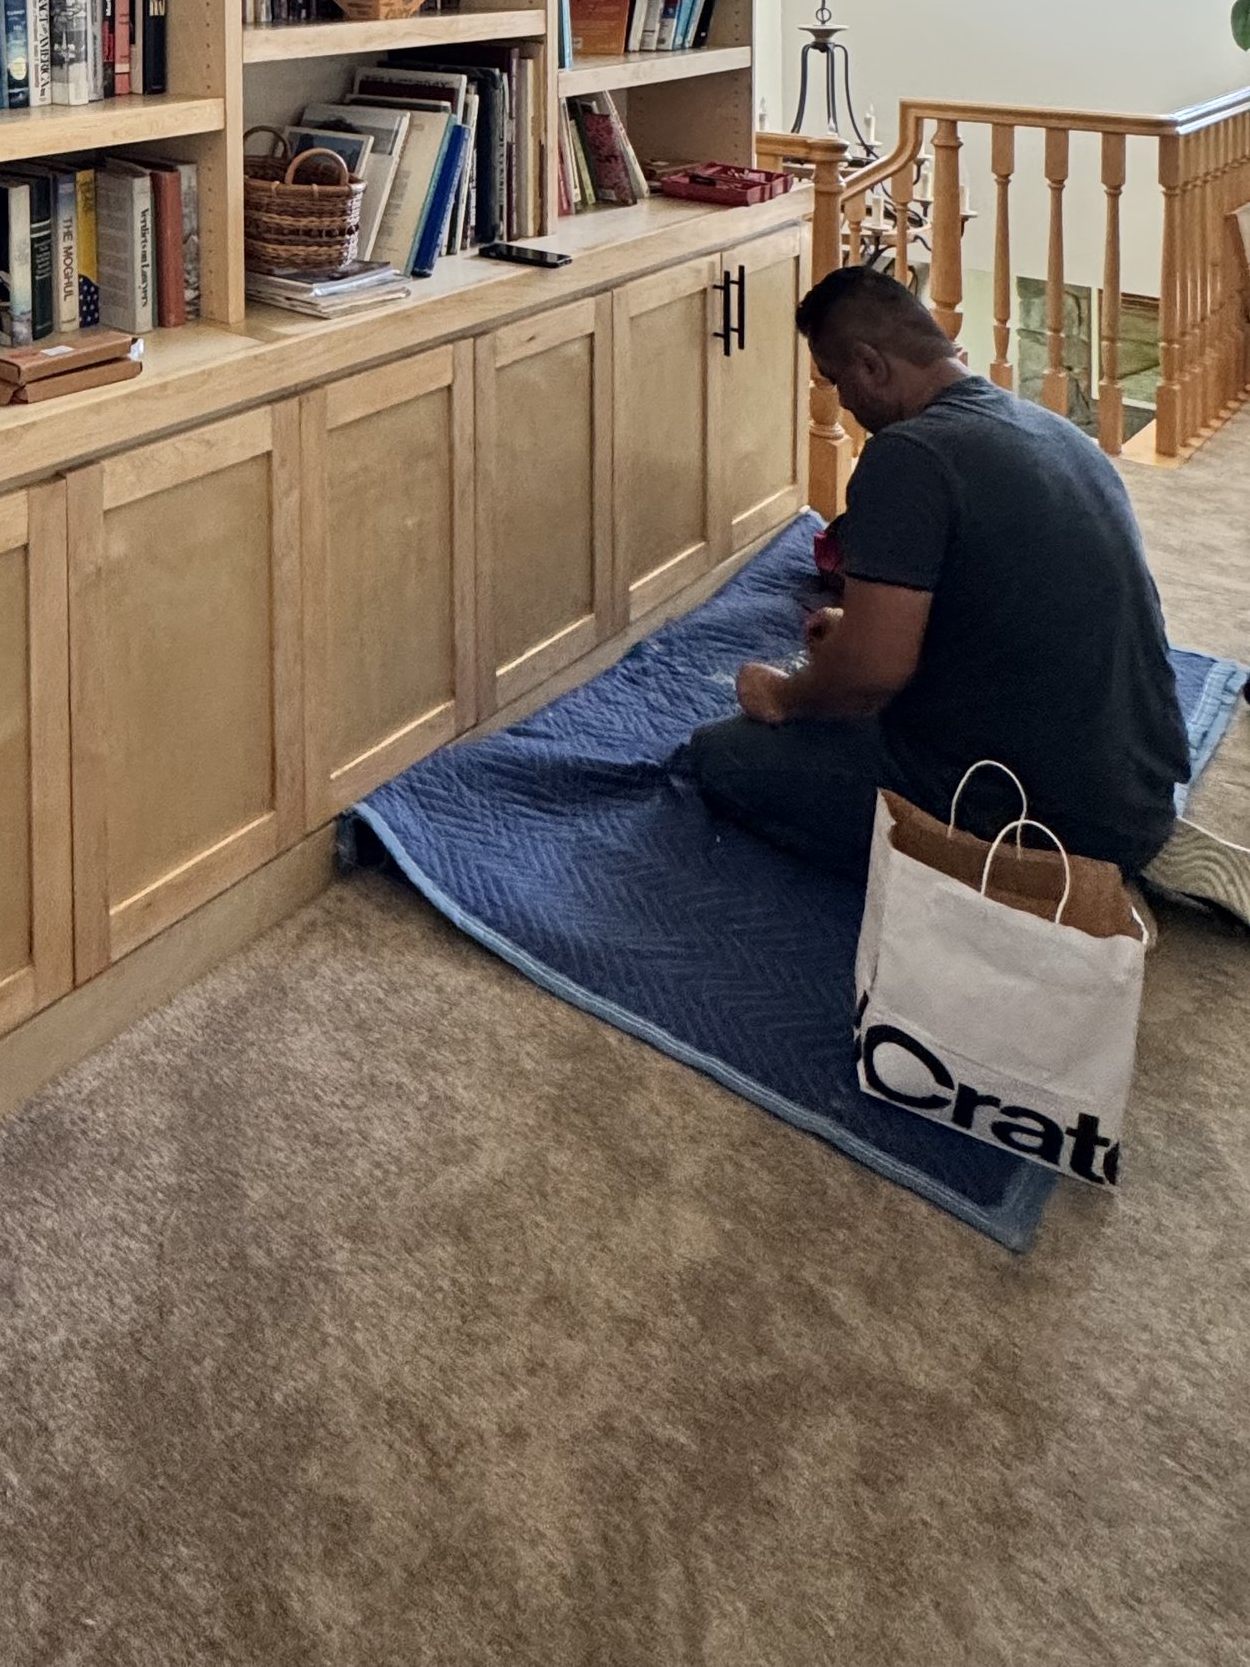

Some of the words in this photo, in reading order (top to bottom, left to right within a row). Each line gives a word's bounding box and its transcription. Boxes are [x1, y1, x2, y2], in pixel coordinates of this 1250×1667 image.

[40, 32, 49, 88] AMERICA
[63, 218, 73, 243] THE
[140, 208, 150, 248] Verdicts
[63, 245, 74, 302] MOGHUL
[140, 263, 150, 307] Lawyers
